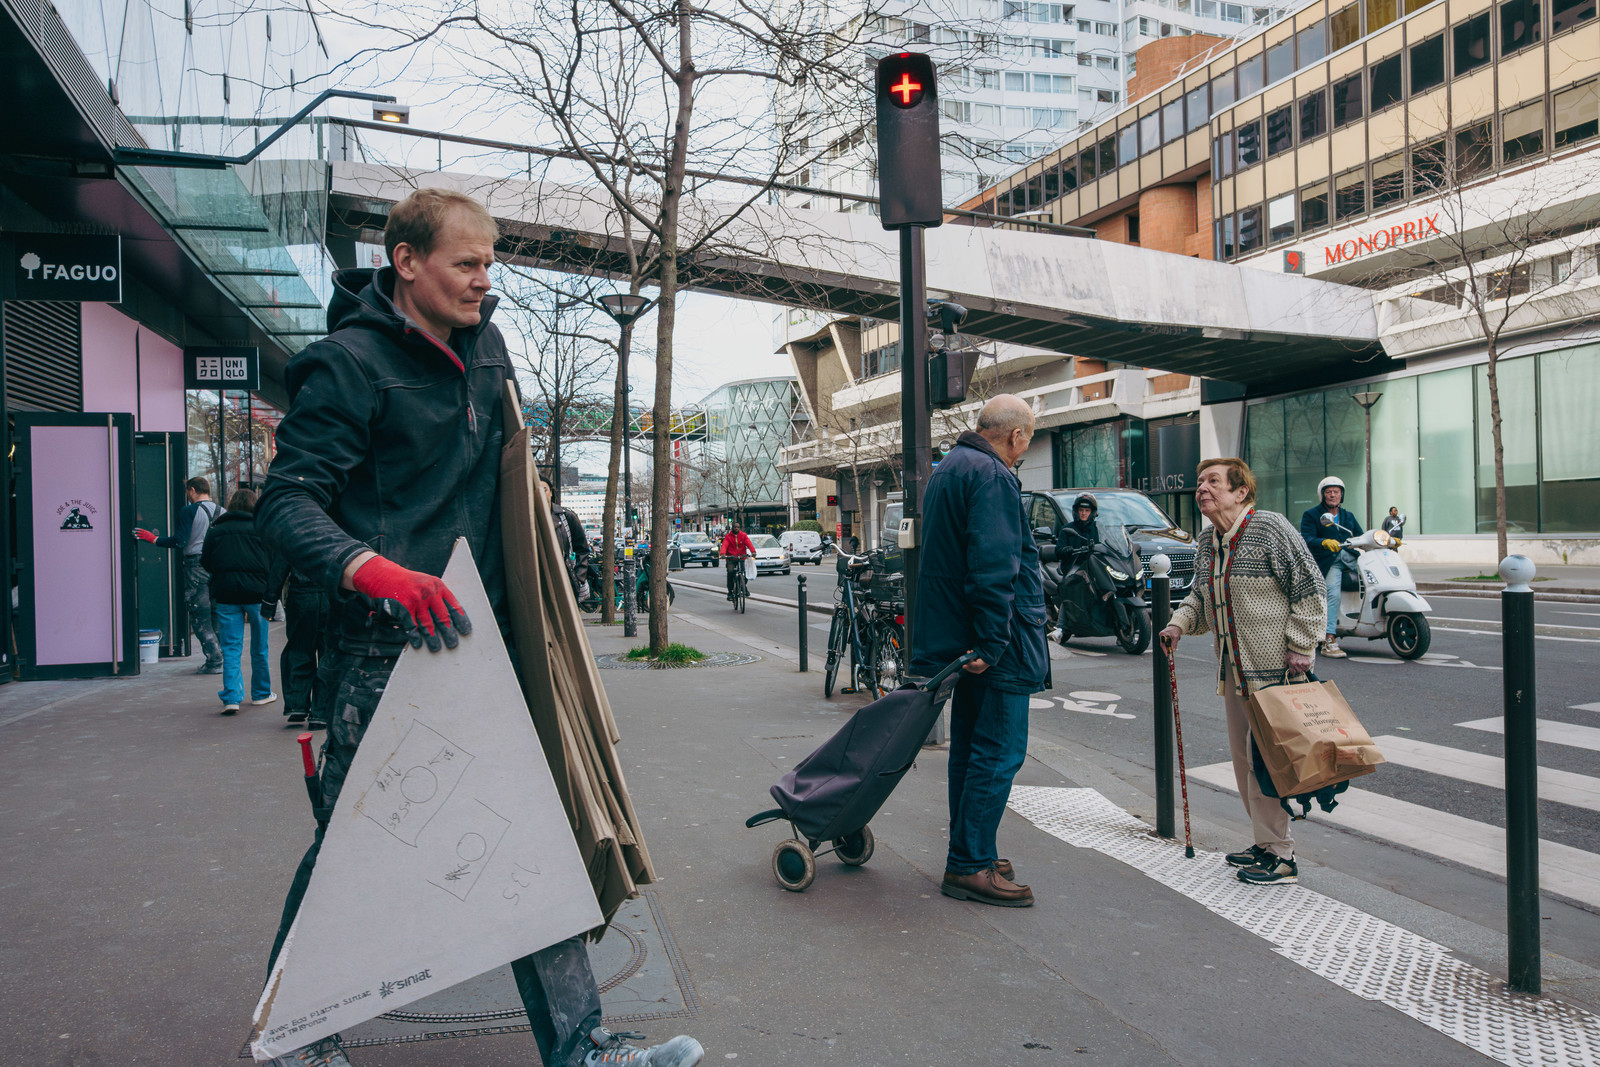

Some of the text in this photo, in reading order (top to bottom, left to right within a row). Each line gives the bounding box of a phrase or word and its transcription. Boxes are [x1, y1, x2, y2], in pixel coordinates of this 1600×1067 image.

[1324, 212, 1440, 266] MONOPRIX
[42, 263, 117, 282] FAGUO
[225, 359, 243, 368] UNI
[225, 369, 245, 378] QLO
[56, 504, 66, 515] JOE
[83, 501, 97, 514] JUICE
[396, 968, 433, 990] siniat
[268, 1023, 290, 1035] avec
[291, 1016, 308, 1027] Eco
[342, 990, 372, 1005] Siniat
